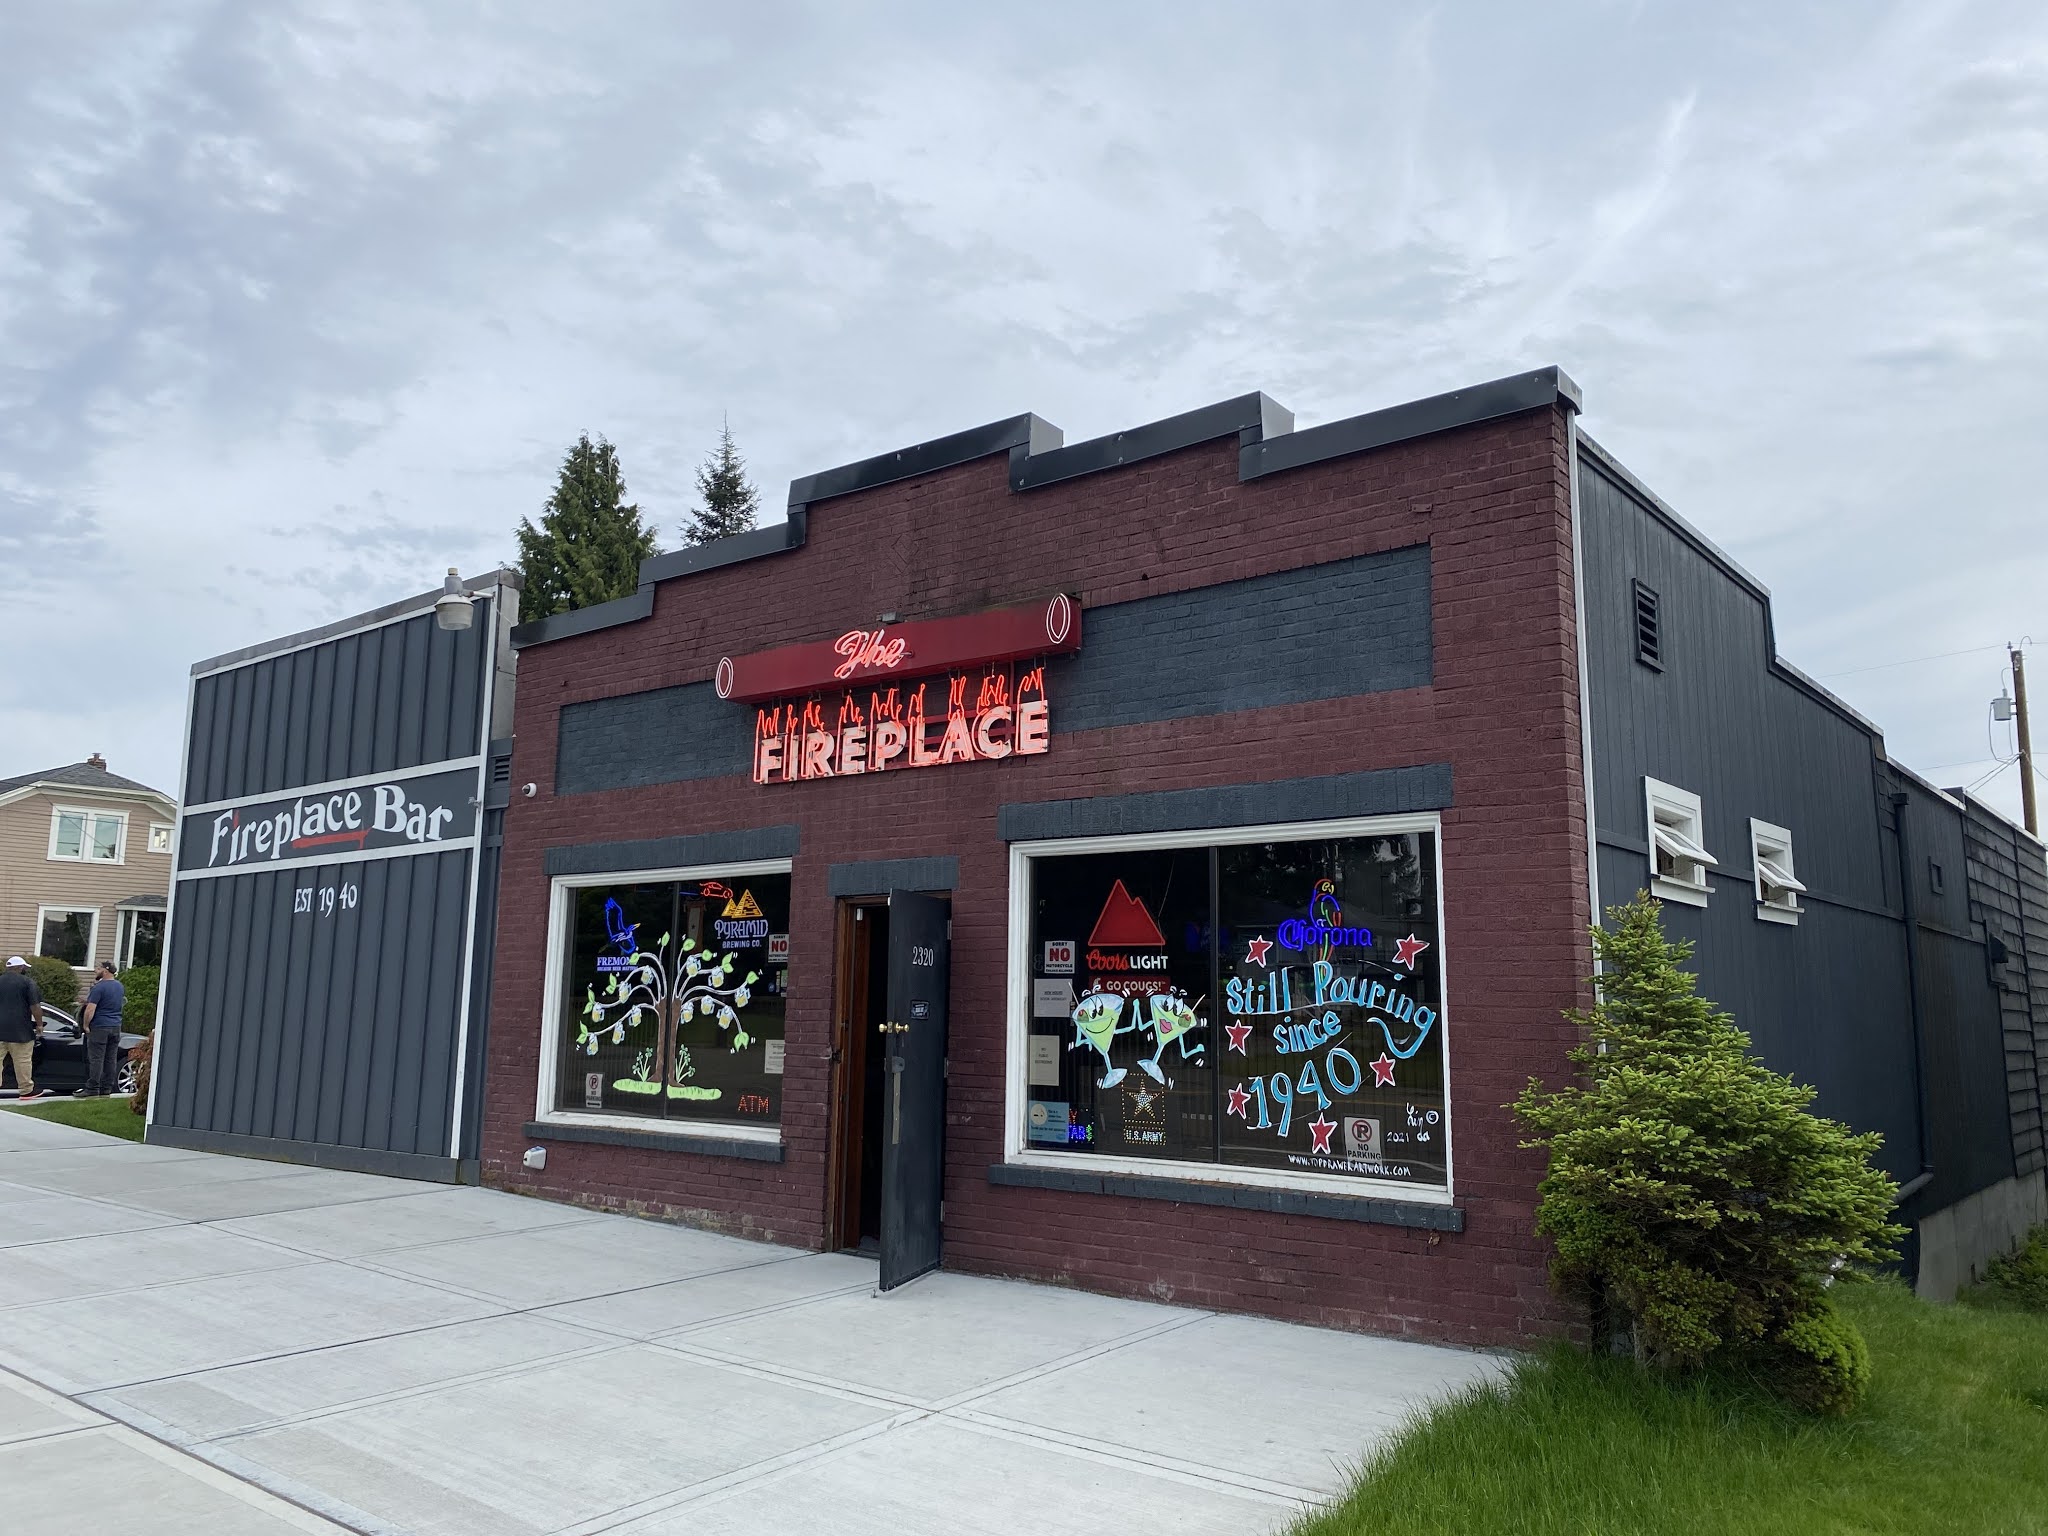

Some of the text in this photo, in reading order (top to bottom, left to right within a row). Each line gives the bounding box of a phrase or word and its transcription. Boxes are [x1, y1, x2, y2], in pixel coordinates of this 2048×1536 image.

[834, 629, 907, 679] The
[754, 700, 1048, 784] FIREPLACE
[208, 784, 453, 867] Fireplace Bar
[294, 887, 313, 913] EST
[714, 919, 768, 939] PYRAMID
[1278, 919, 1372, 951] Corona
[722, 939, 762, 949] BREWING CO.
[771, 940, 787, 952] NO
[912, 946, 934, 967] 2320
[1049, 948, 1071, 962] NO
[1086, 949, 1168, 970] Coors LIGHT
[1106, 981, 1162, 991] GO COUGS!
[1226, 960, 1436, 1059] Still Pouring
[1273, 1010, 1341, 1054] since
[1248, 1047, 1361, 1137] 1940
[738, 1094, 769, 1114] ATM
[1126, 1130, 1163, 1142] U.S. ARMY
[1386, 1131, 1410, 1143] 2021
[1347, 1150, 1382, 1160] PARKING
[1358, 1143, 1369, 1151] NO
